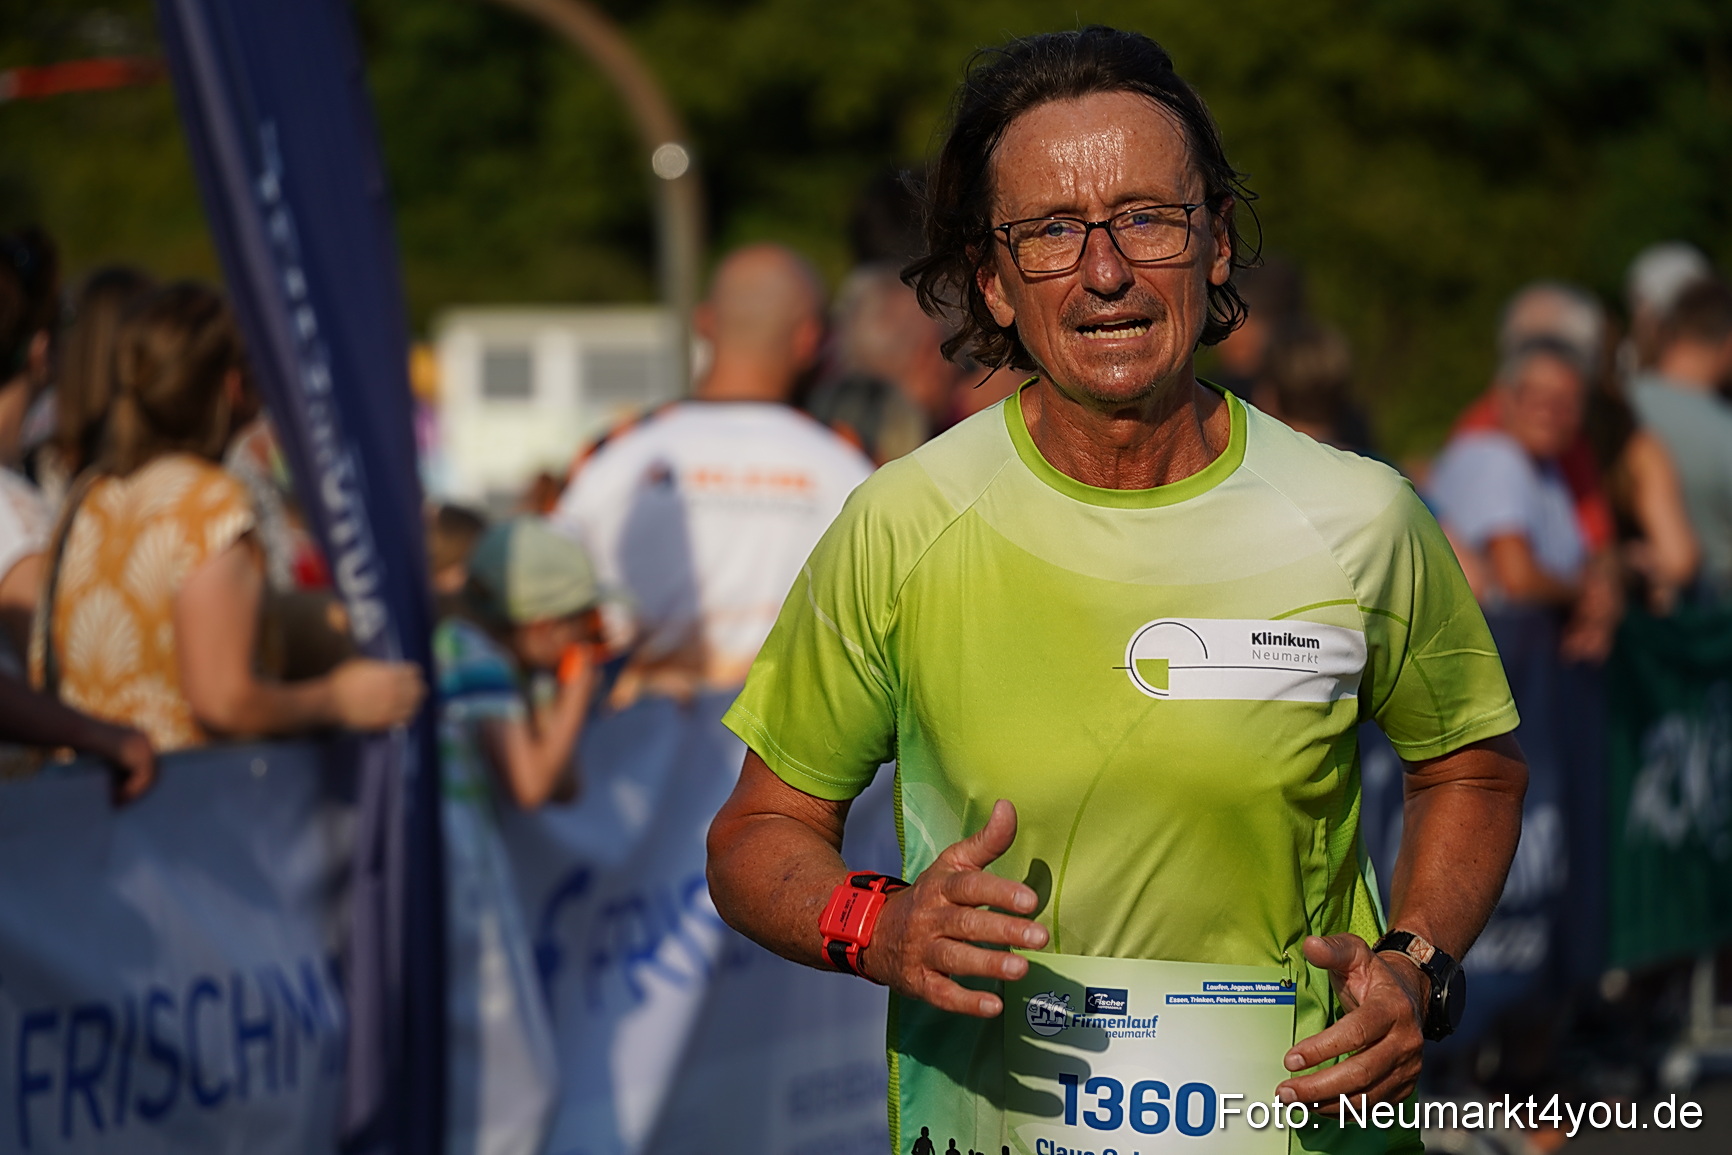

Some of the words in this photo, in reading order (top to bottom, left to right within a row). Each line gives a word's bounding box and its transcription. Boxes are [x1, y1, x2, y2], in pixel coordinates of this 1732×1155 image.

[1252, 632, 1320, 649] Klinikum
[1252, 649, 1318, 664] Neumarkt
[1230, 984, 1255, 992] Joggen,
[1094, 994, 1125, 1007] Fischer
[1169, 996, 1190, 1004] Essen,
[1190, 996, 1215, 1004] Trinken,
[1216, 996, 1238, 1004] Feiern,
[1238, 996, 1276, 1004] Netzwerken
[1071, 1014, 1159, 1029] Firmenlauf
[1105, 1029, 1157, 1039] neumarkt
[1058, 1073, 1217, 1137] 1360
